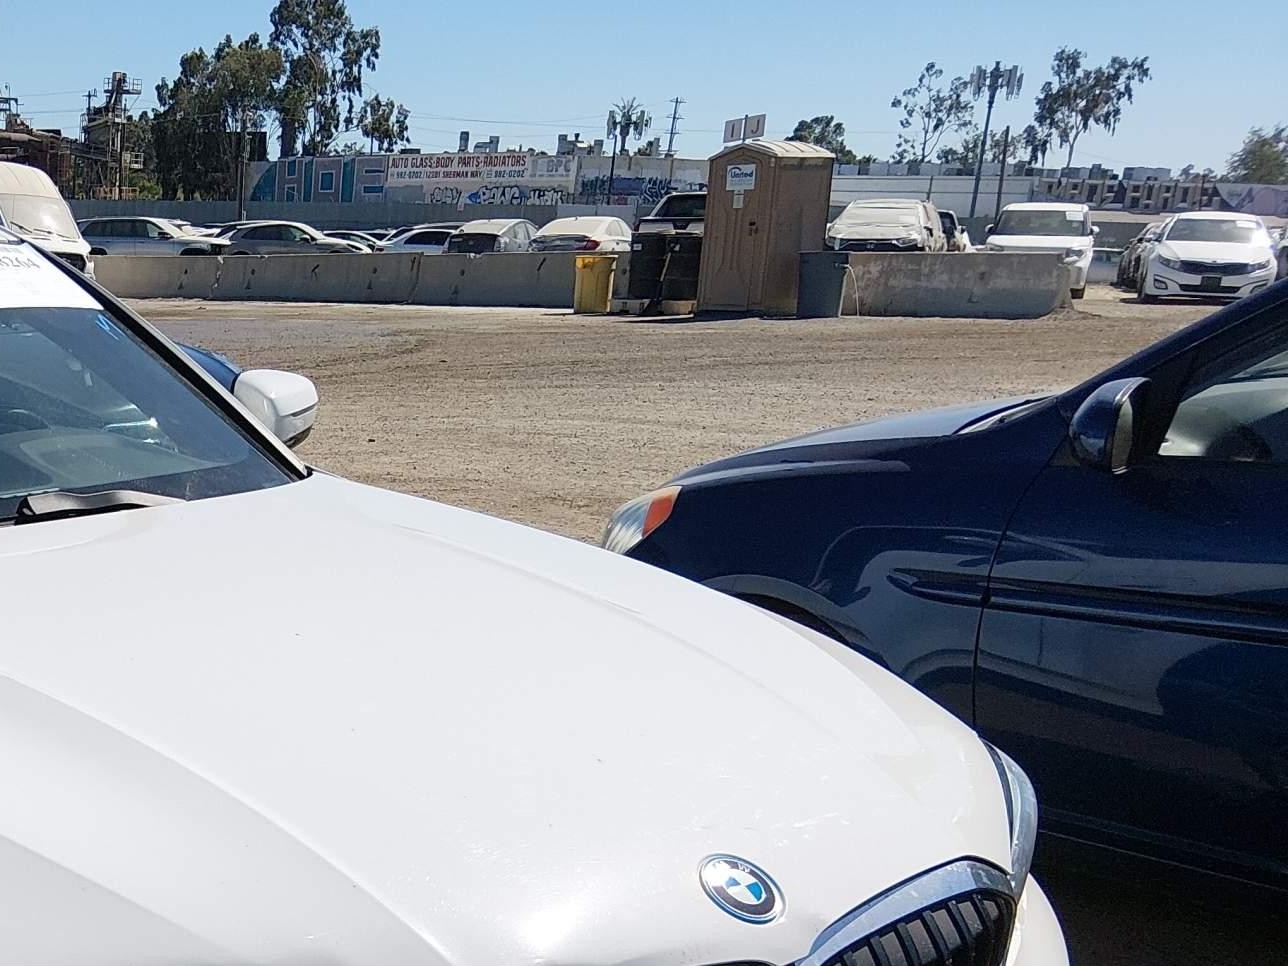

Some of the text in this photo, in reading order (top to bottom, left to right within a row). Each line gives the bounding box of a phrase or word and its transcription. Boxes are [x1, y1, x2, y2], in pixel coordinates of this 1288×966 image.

[751, 119, 760, 134] J
[391, 157, 409, 169] AUTO
[442, 170, 469, 179] SHERMAN
